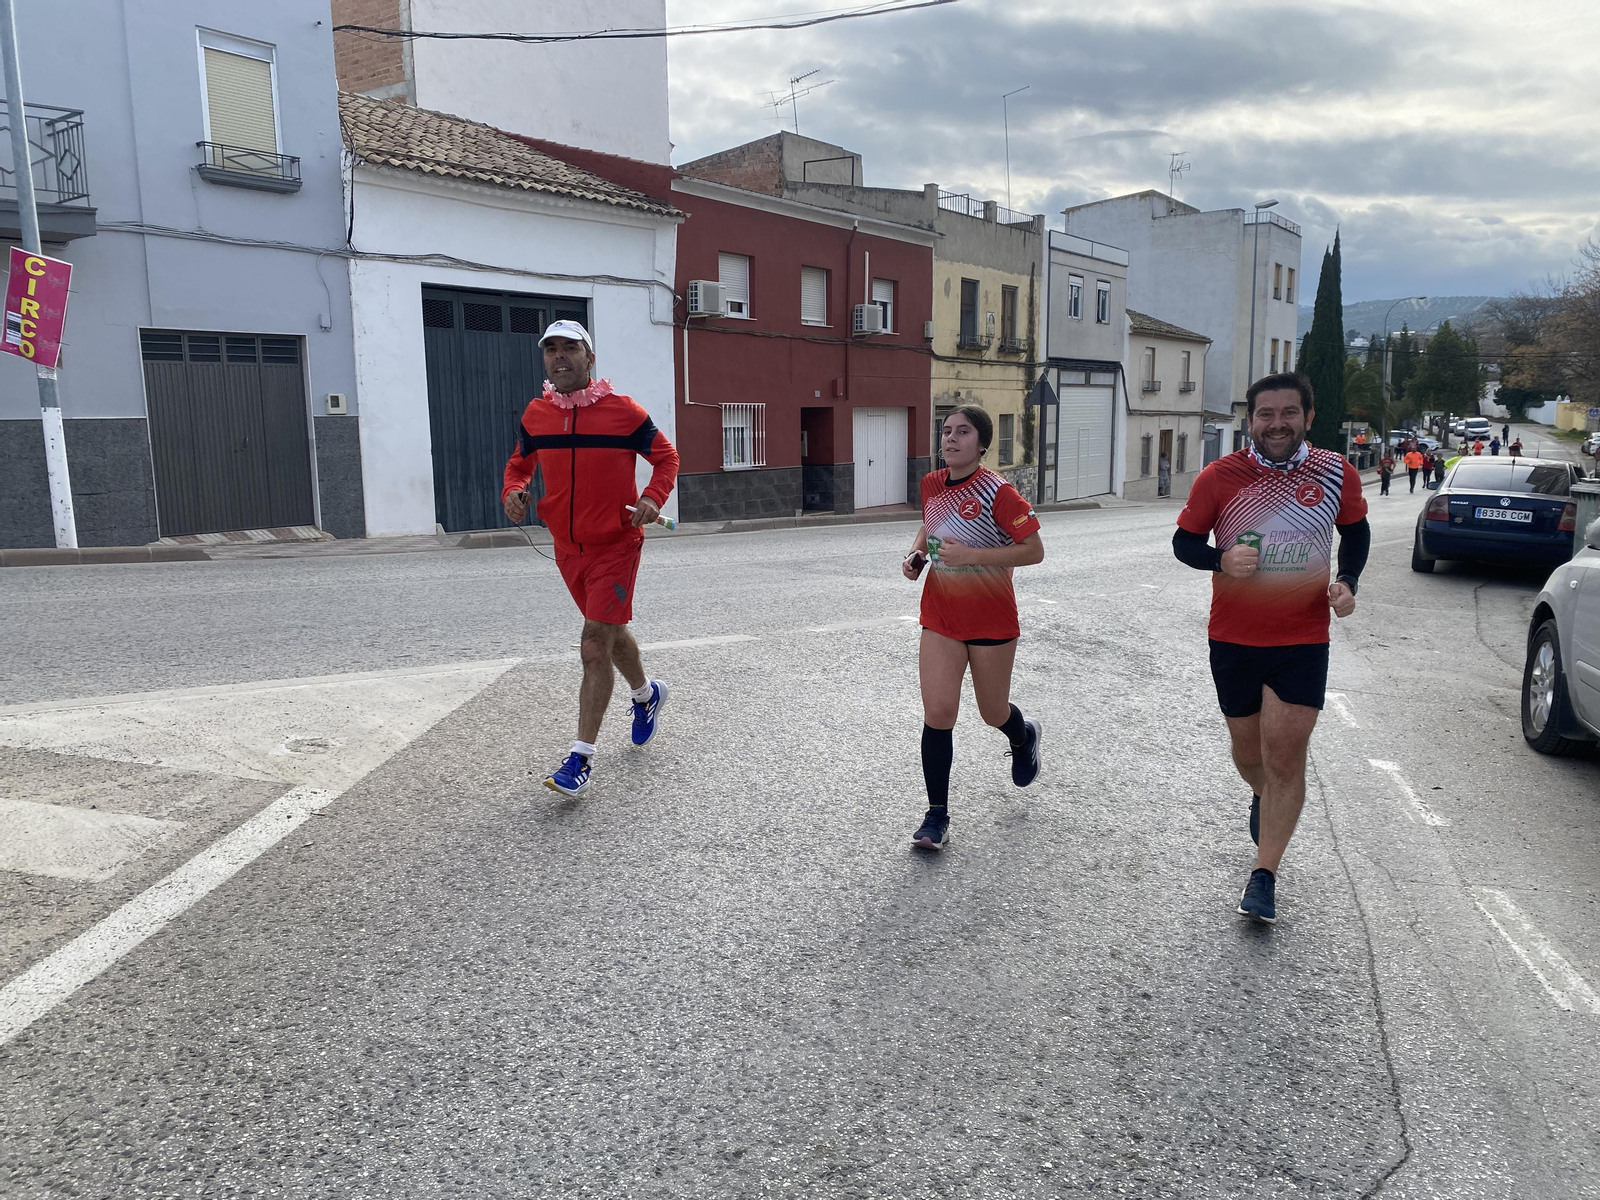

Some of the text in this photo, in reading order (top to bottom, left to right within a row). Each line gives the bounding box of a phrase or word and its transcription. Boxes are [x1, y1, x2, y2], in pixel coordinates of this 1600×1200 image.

[20, 256, 46, 358] CIRCO
[1481, 509, 1530, 521] 8336 CGM
[1262, 542, 1313, 564] ALBOR
